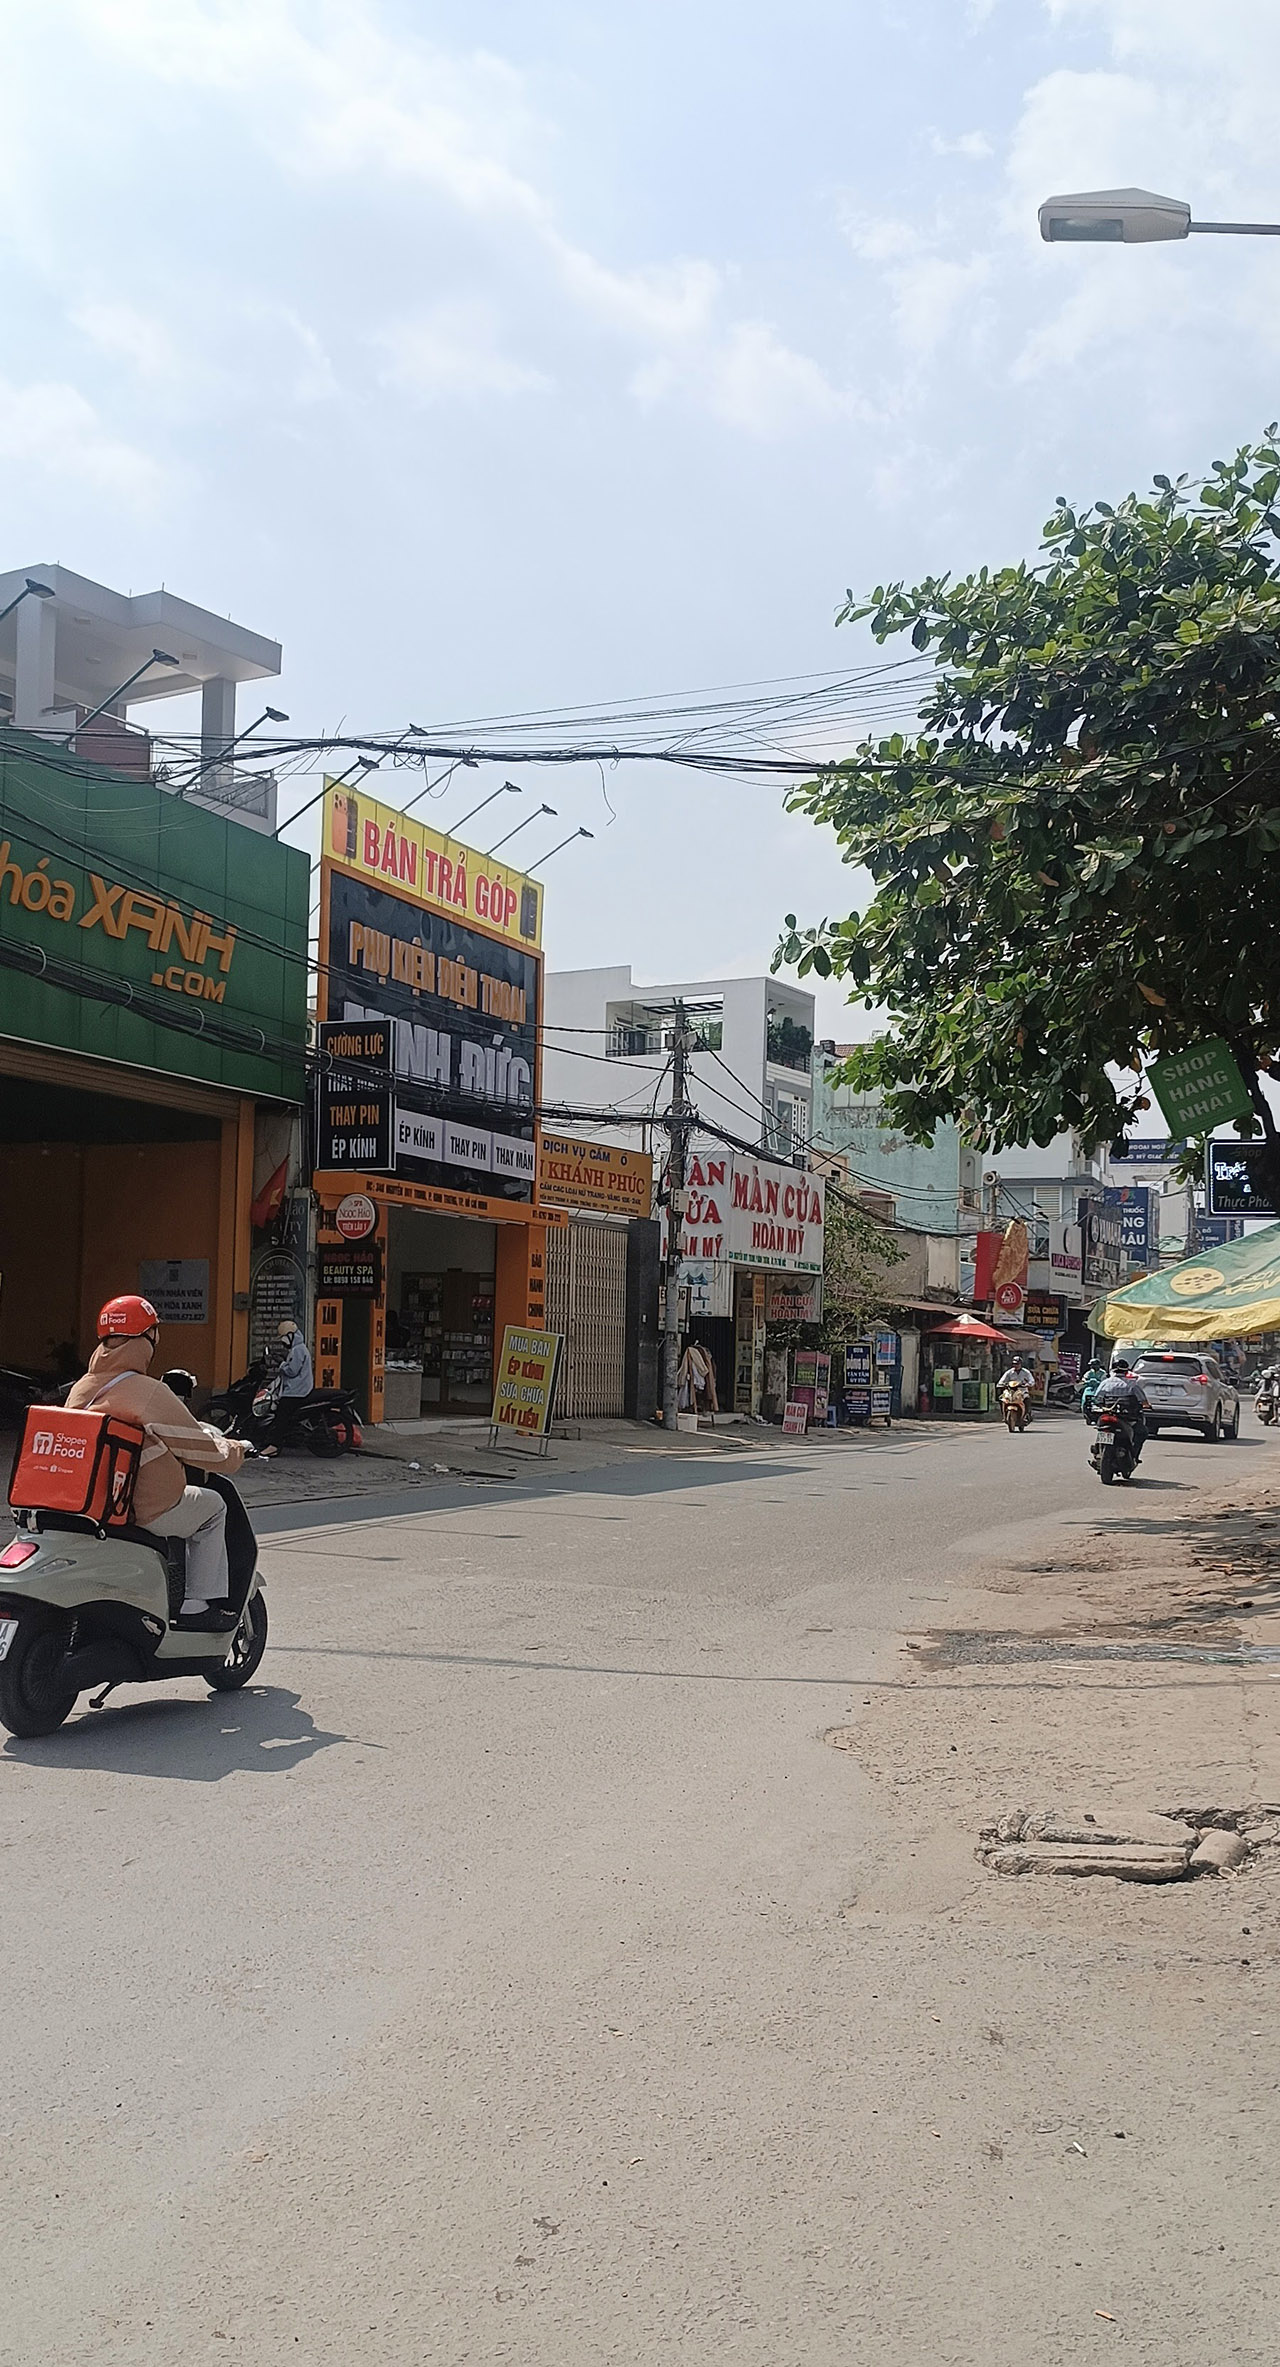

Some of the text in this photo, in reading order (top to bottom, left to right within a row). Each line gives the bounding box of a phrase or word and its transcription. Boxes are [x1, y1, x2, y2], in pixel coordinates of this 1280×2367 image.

[363, 820, 518, 927] BÁN TRẢ GÓP
[77, 873, 237, 973] XANH
[151, 966, 227, 1004] .COM
[349, 921, 526, 1032] PHỤ KIỆN ĐIỆN THOẠI
[327, 1031, 384, 1059] CƯỜNG LỰC
[459, 1034, 530, 1118] ĐỨC
[1162, 1051, 1217, 1082] SHOP
[1168, 1070, 1228, 1103] HÀNG
[330, 1104, 379, 1126] THAY PIN
[331, 1133, 377, 1159] ÉP KÍNH
[399, 1121, 435, 1149] ÉP KÍNH
[450, 1136, 487, 1160] THAY PIN
[496, 1147, 515, 1167] THAY
[543, 1140, 568, 1154] DỊCH
[572, 1145, 586, 1160] VỤ
[548, 1161, 605, 1188] KHÁNH
[608, 1171, 645, 1195] PHÚC
[665, 1155, 726, 1187] ÀN
[666, 1190, 721, 1225] ỬA
[732, 1165, 822, 1225] MÀN CỬA
[1217, 1195, 1246, 1210] Thực
[1123, 1217, 1145, 1228] NG
[703, 1233, 723, 1258] MỸ
[752, 1218, 805, 1255] HOÀN MỸ
[323, 1265, 374, 1275] BEAUTY SPA
[508, 1336, 550, 1357] MUA BÁN
[508, 1356, 520, 1375] ÉP
[500, 1378, 544, 1405] SỬA CHỮA
[498, 1402, 517, 1424] LẤY
[53, 1444, 85, 1459] Food
[56, 1432, 87, 1446] Shopee
